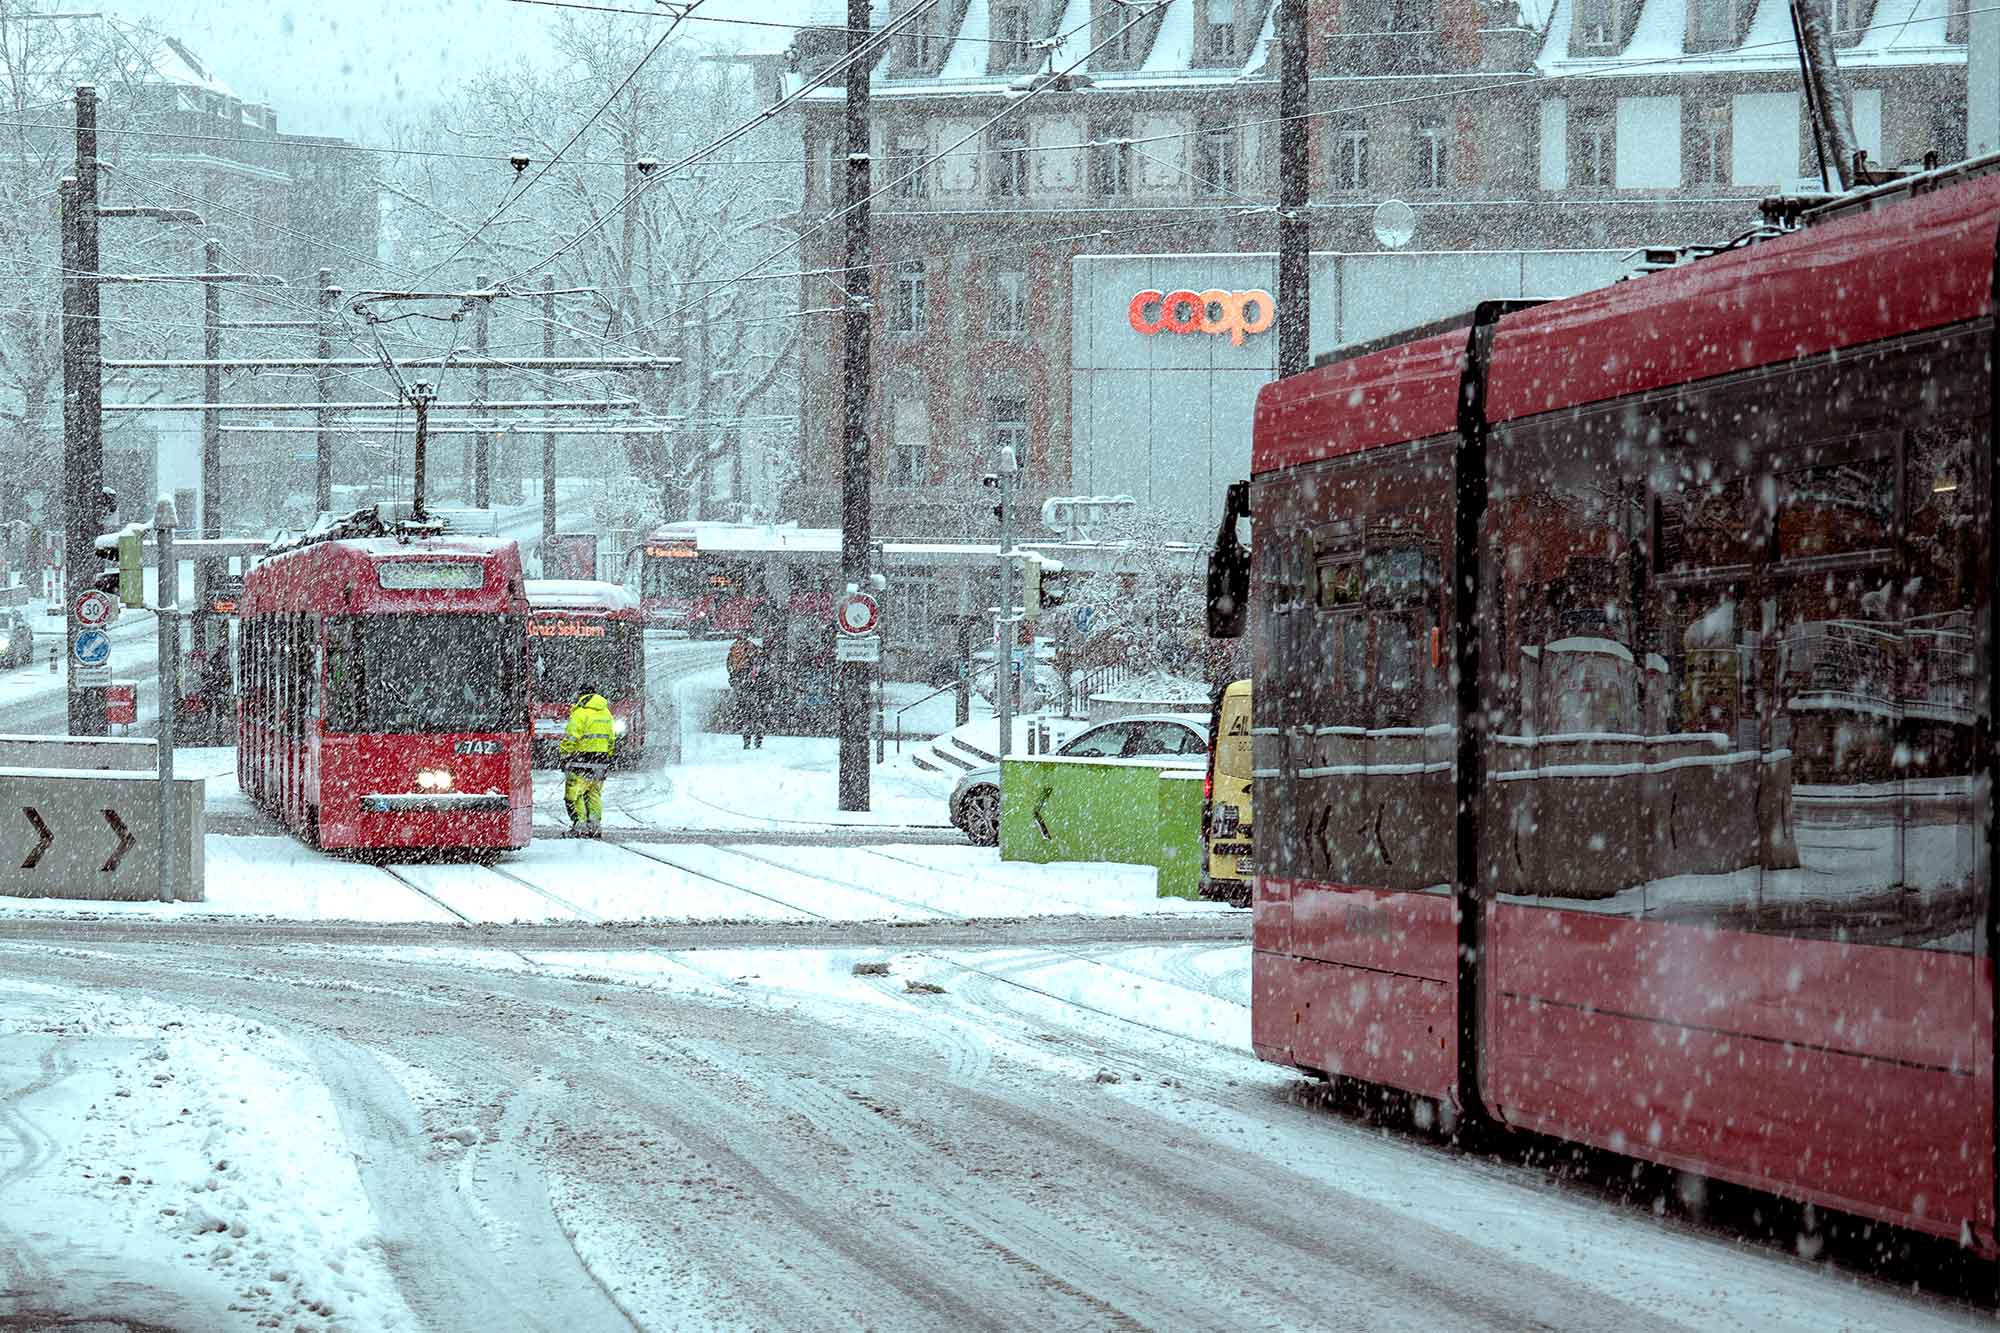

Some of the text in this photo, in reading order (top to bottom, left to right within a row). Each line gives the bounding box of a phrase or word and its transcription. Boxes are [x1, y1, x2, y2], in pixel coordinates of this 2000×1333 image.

[1128, 288, 1276, 346] coop
[85, 603, 99, 616] 30
[464, 740, 497, 754] 742
